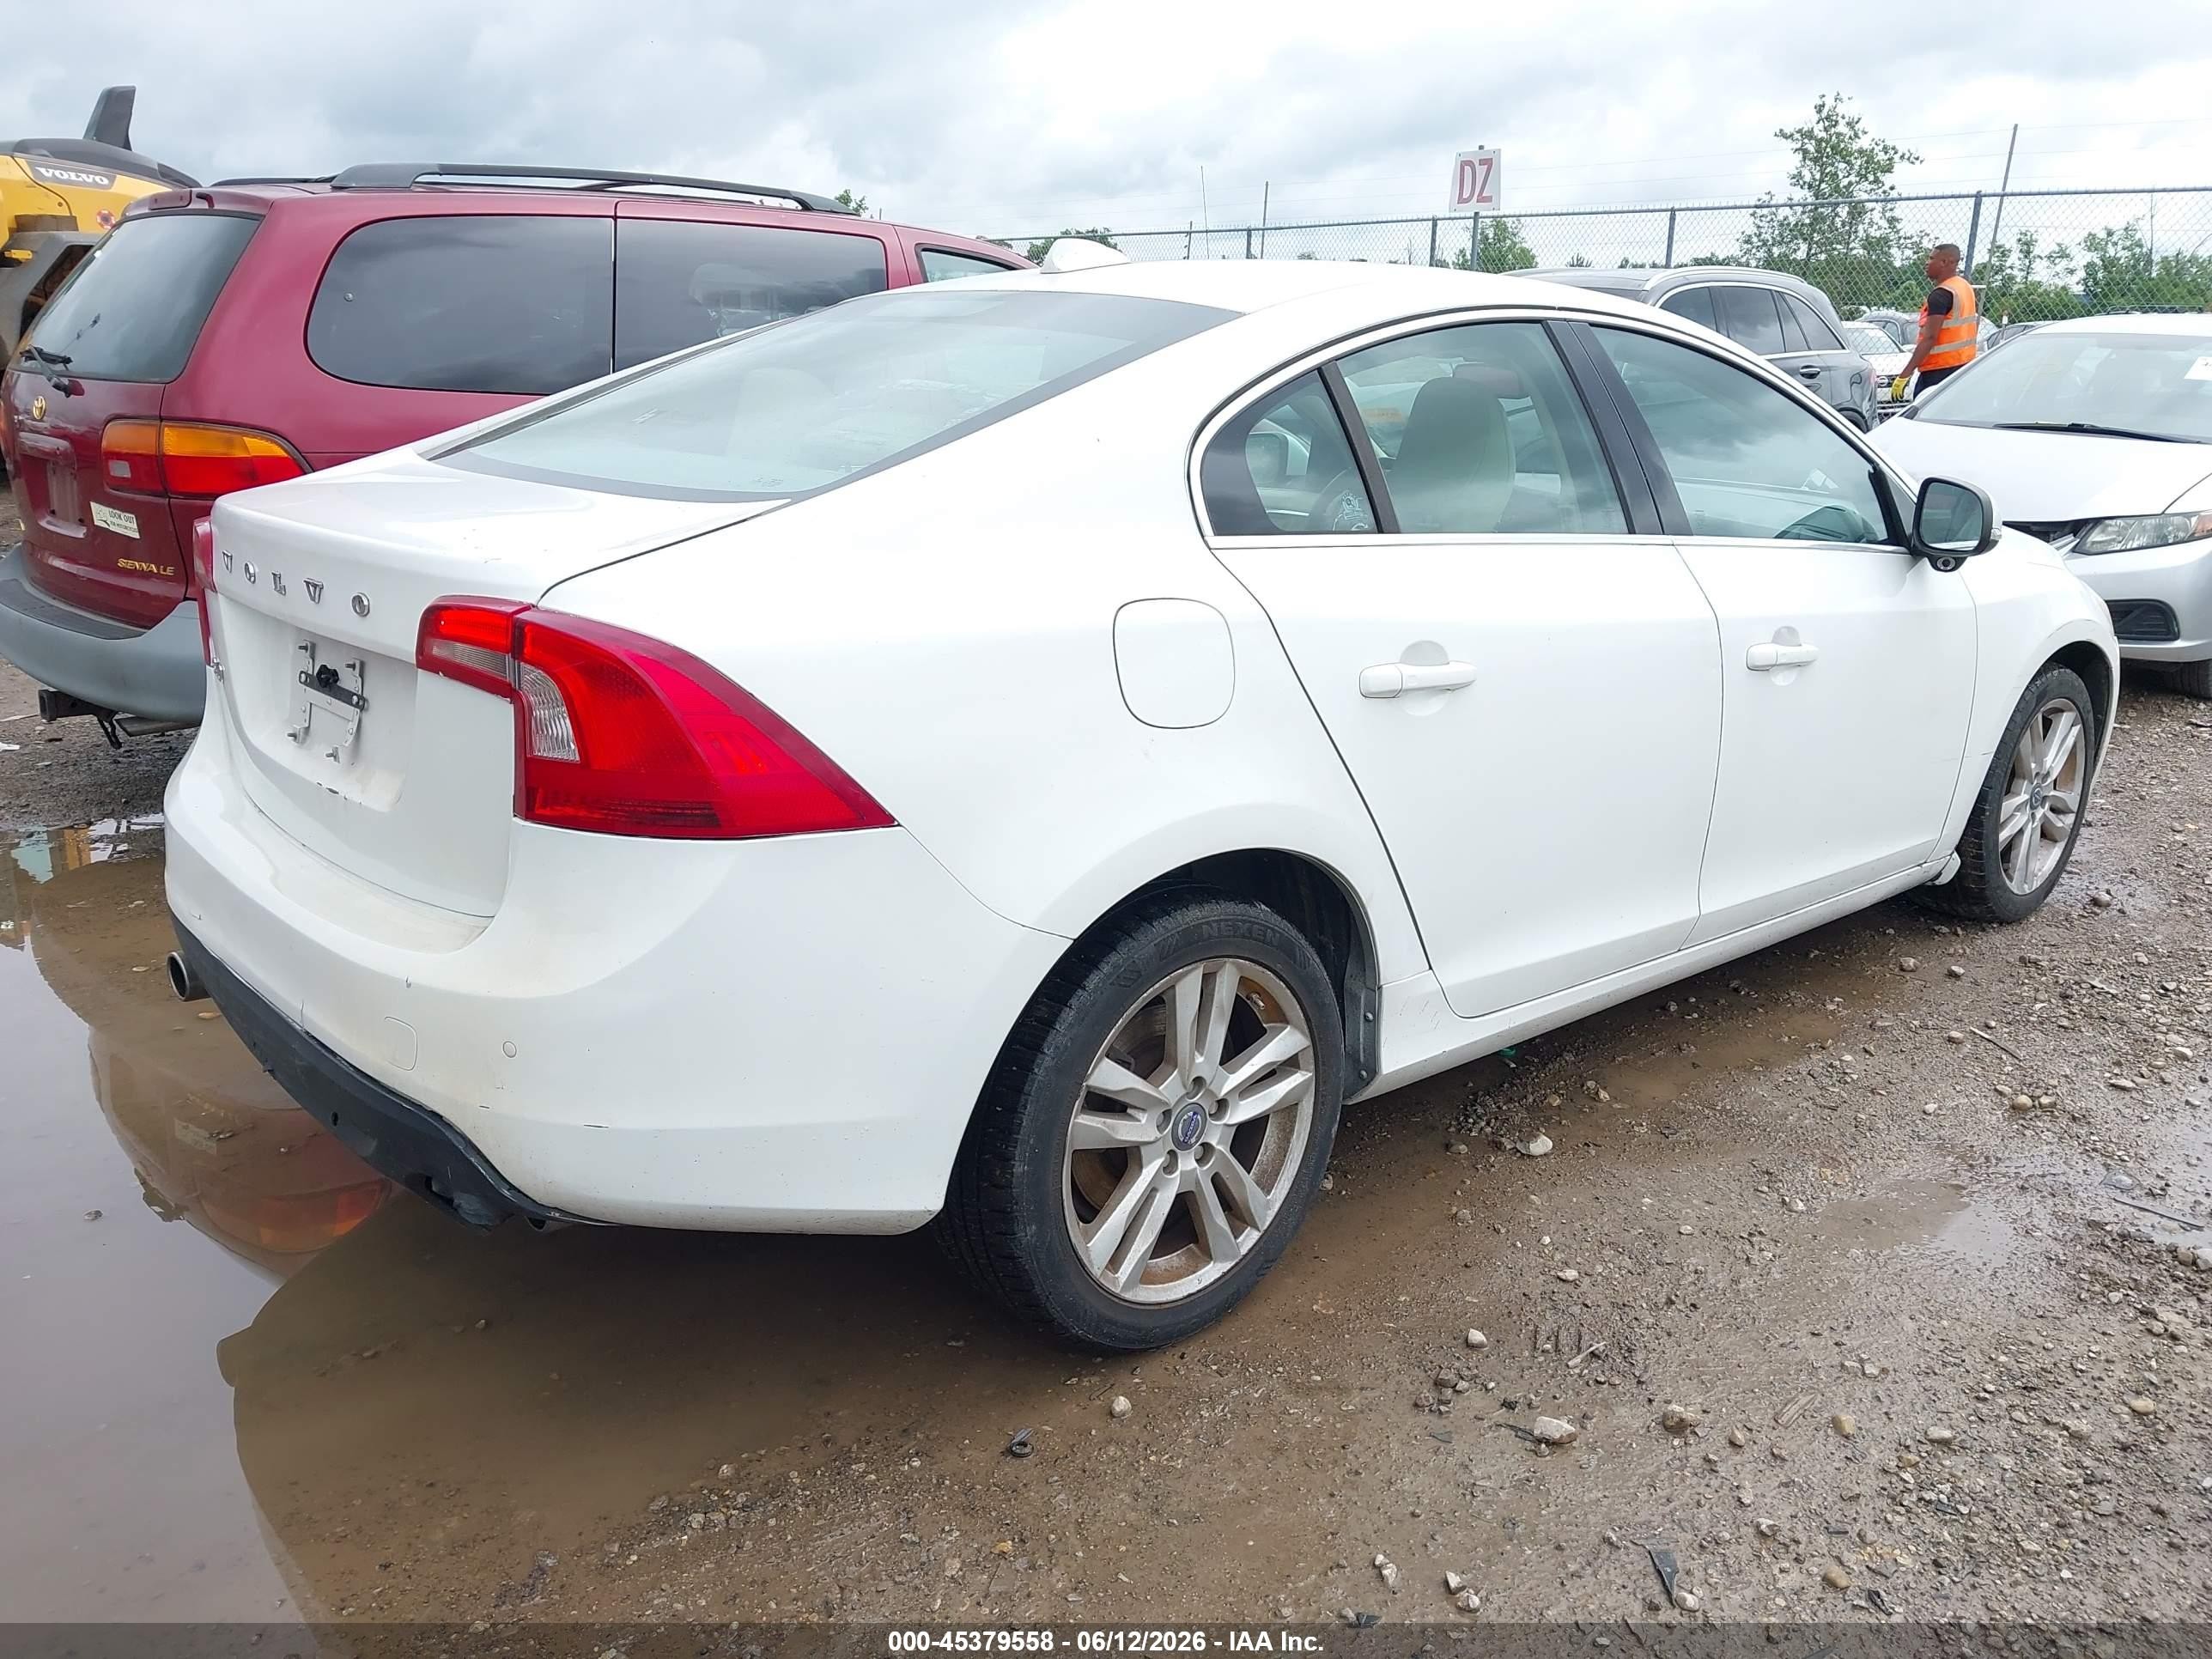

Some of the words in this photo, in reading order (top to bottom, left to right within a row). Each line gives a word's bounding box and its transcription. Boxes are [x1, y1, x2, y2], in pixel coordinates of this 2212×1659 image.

[34, 167, 109, 185] VOLVO
[1457, 157, 1493, 204] DZ
[109, 509, 122, 520] LOOK
[123, 514, 135, 525] OUT
[118, 558, 157, 573] SIENNA
[160, 566, 174, 575] LE
[222, 550, 370, 617] VOLVO
[1202, 921, 1281, 946] NEXEN
